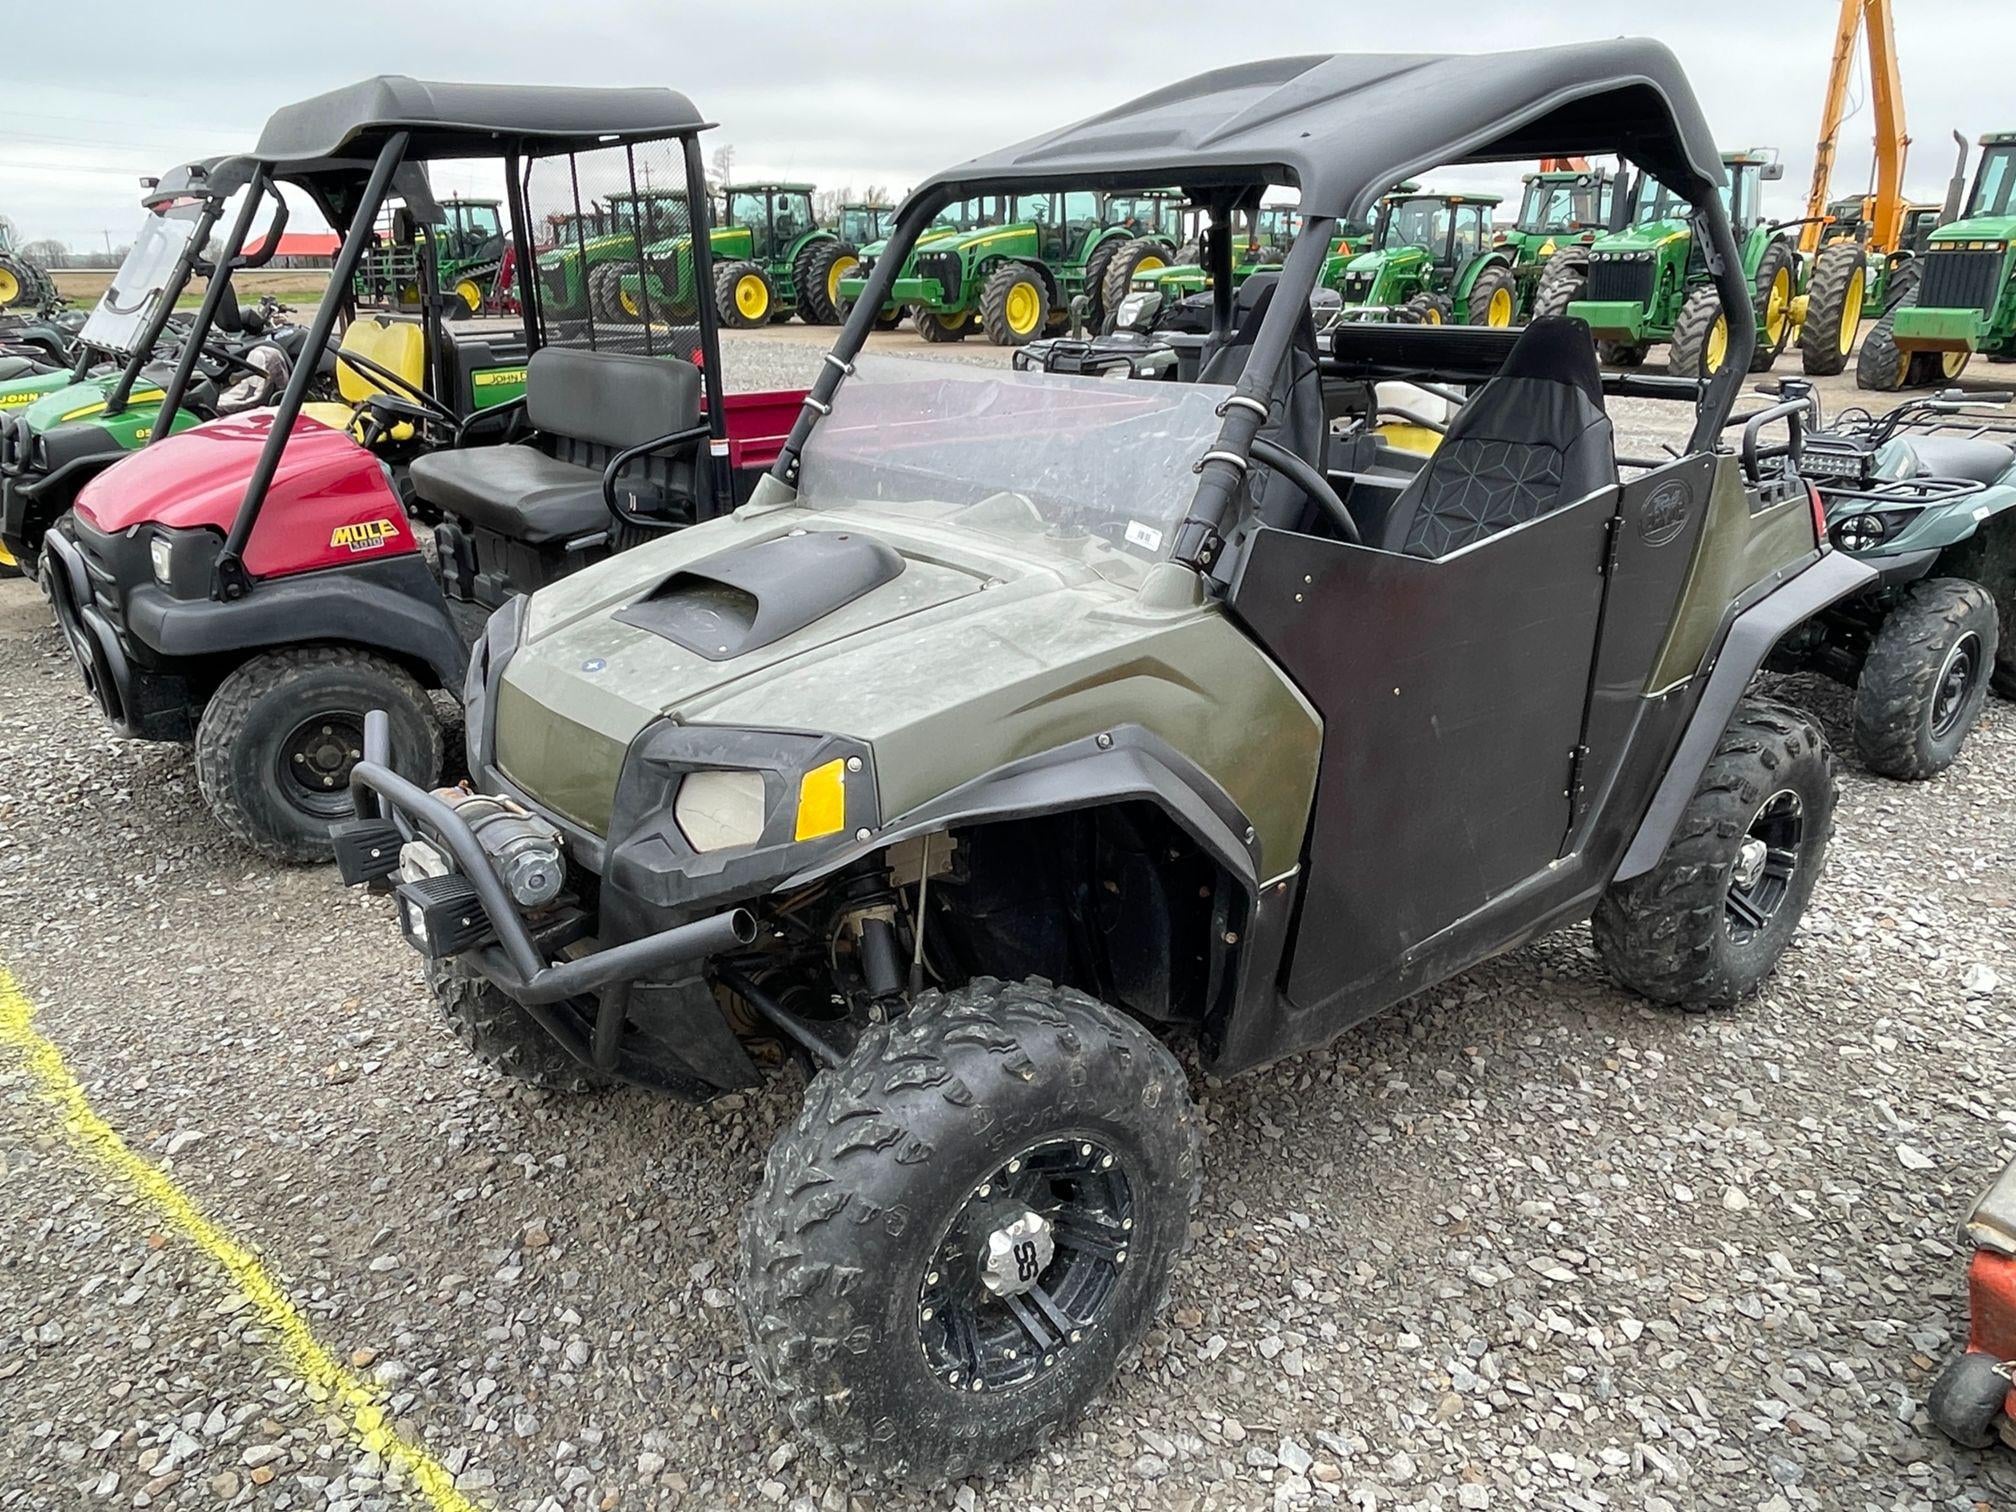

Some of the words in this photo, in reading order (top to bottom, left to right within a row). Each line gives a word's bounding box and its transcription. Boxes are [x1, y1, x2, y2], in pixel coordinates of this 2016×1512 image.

[491, 373, 518, 384] JOHN
[0, 392, 39, 404] JOHN
[135, 428, 153, 439] 85
[333, 520, 397, 545] MULE
